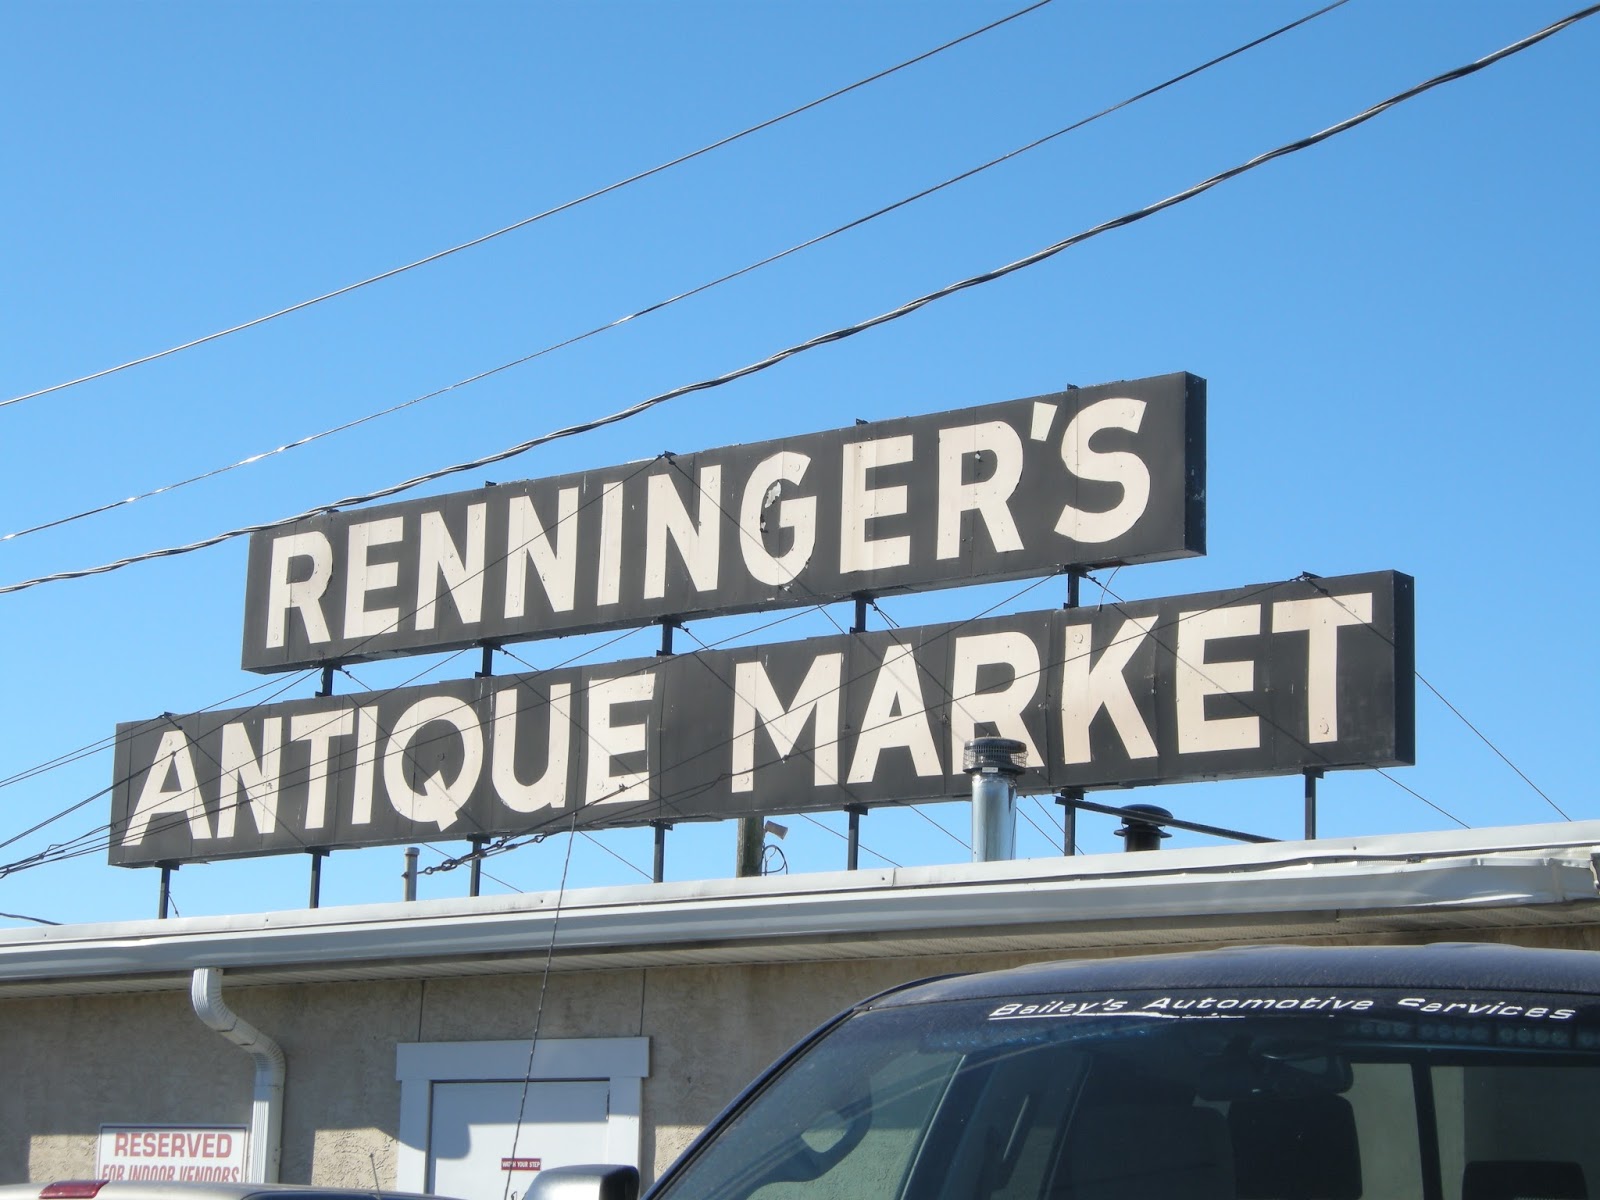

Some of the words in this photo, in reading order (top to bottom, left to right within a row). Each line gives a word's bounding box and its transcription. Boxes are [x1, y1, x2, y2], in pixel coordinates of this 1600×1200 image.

[265, 397, 1151, 650] RENNINGER'S
[121, 673, 656, 847] ANTIQUE
[730, 592, 1373, 794] MARKET
[988, 998, 1129, 1018] Bailey's
[1142, 996, 1374, 1011] Automotive
[114, 1131, 233, 1158] RESERVED
[101, 1164, 125, 1181] FOR
[128, 1165, 176, 1182] INDOOR
[180, 1165, 240, 1183] VENDORS
